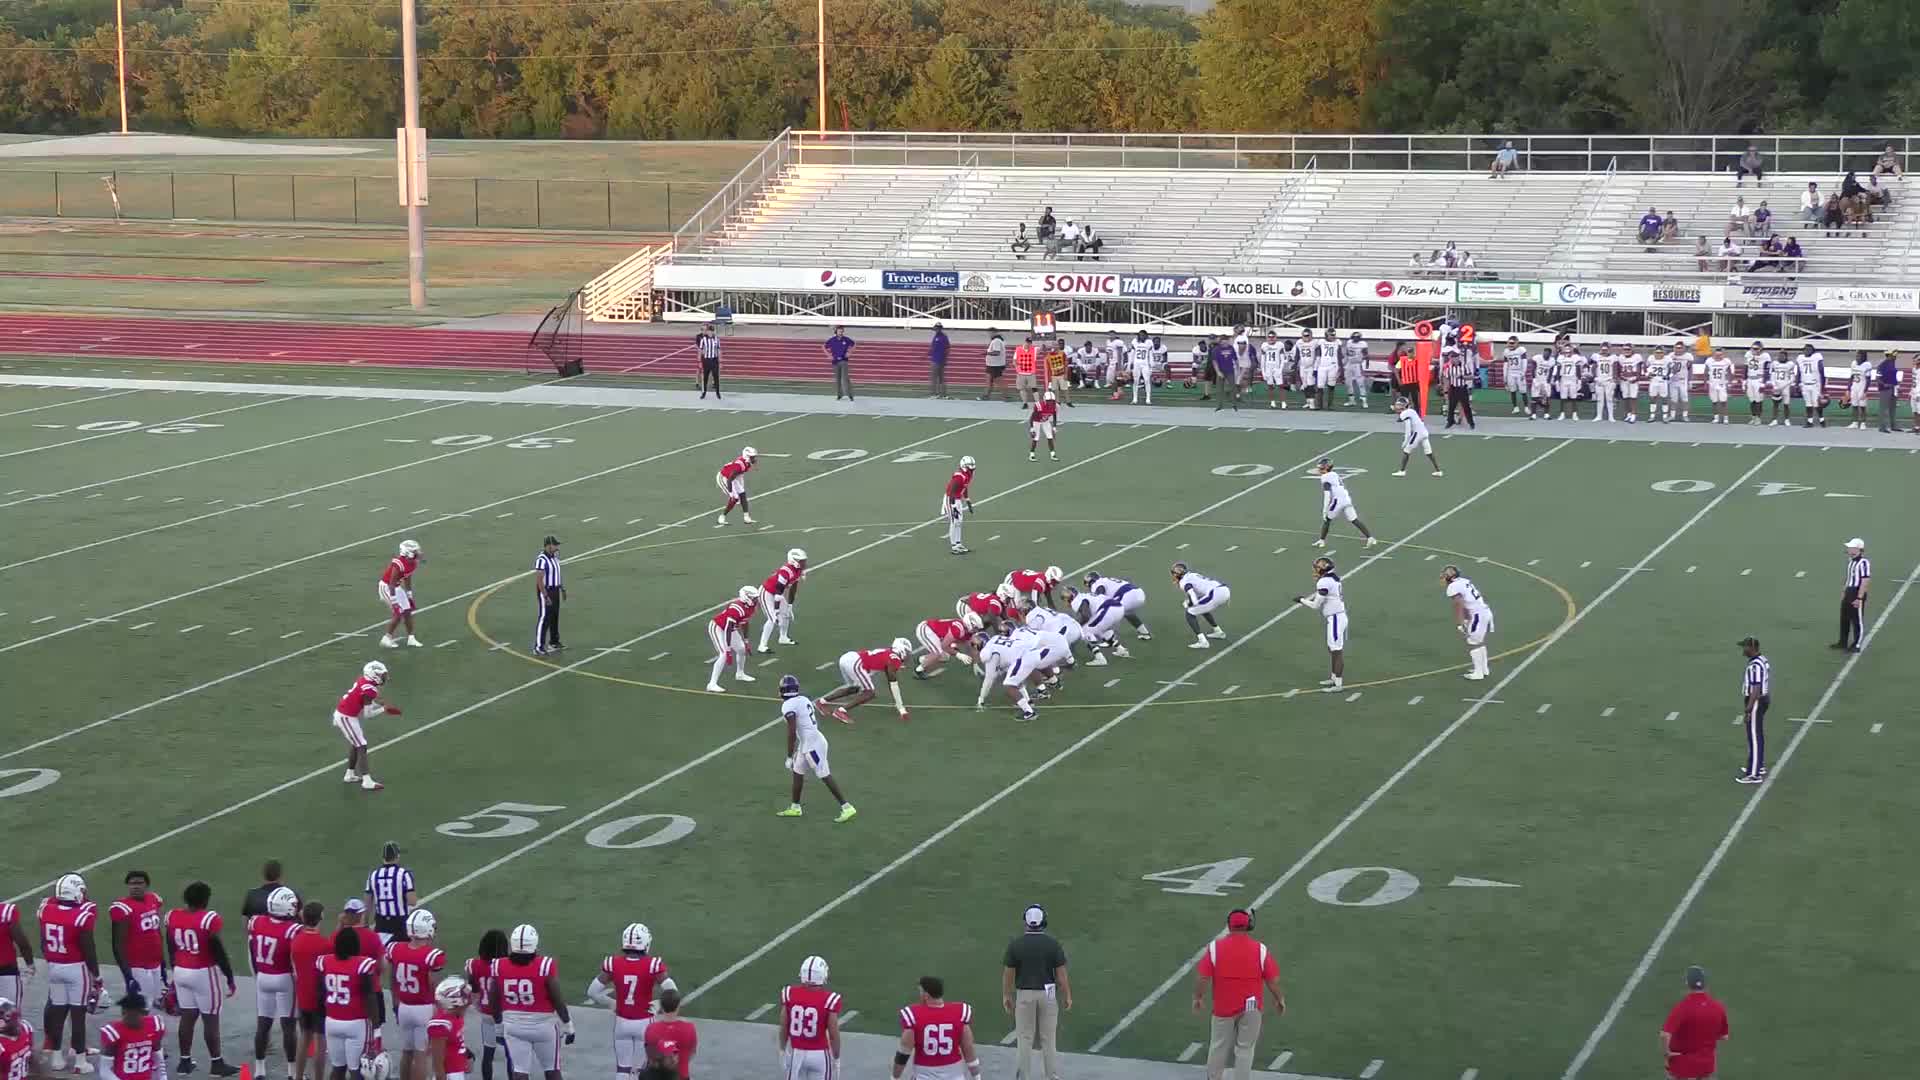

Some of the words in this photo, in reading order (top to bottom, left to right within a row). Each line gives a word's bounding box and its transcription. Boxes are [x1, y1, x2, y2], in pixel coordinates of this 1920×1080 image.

[840, 274, 866, 285] pepsi
[886, 271, 956, 287] Travelodge
[1043, 275, 1115, 293] SONIC
[1122, 277, 1175, 294] TAYLOR
[1224, 283, 1254, 295] TACO
[1256, 284, 1283, 295] BELL
[1311, 280, 1358, 299] SMC
[1397, 286, 1427, 297] Pizza
[1428, 286, 1450, 297] Hut
[1567, 286, 1617, 299] Coffeyville
[1653, 289, 1701, 299] RESOURCES
[1742, 286, 1798, 297] DESIGNS
[1460, 325, 1474, 341] 2
[435, 802, 697, 850] 50
[376, 878, 394, 899] H
[1142, 857, 1421, 907] 40
[45, 923, 67, 954] 51
[174, 928, 200, 954] 40
[256, 935, 278, 965] 17
[325, 974, 350, 1005] 95
[396, 962, 420, 994] 45
[623, 974, 638, 1005] 7
[503, 978, 534, 1005] 58
[789, 1004, 818, 1038] 83
[923, 1023, 953, 1056] 65
[123, 1046, 152, 1073] 82
